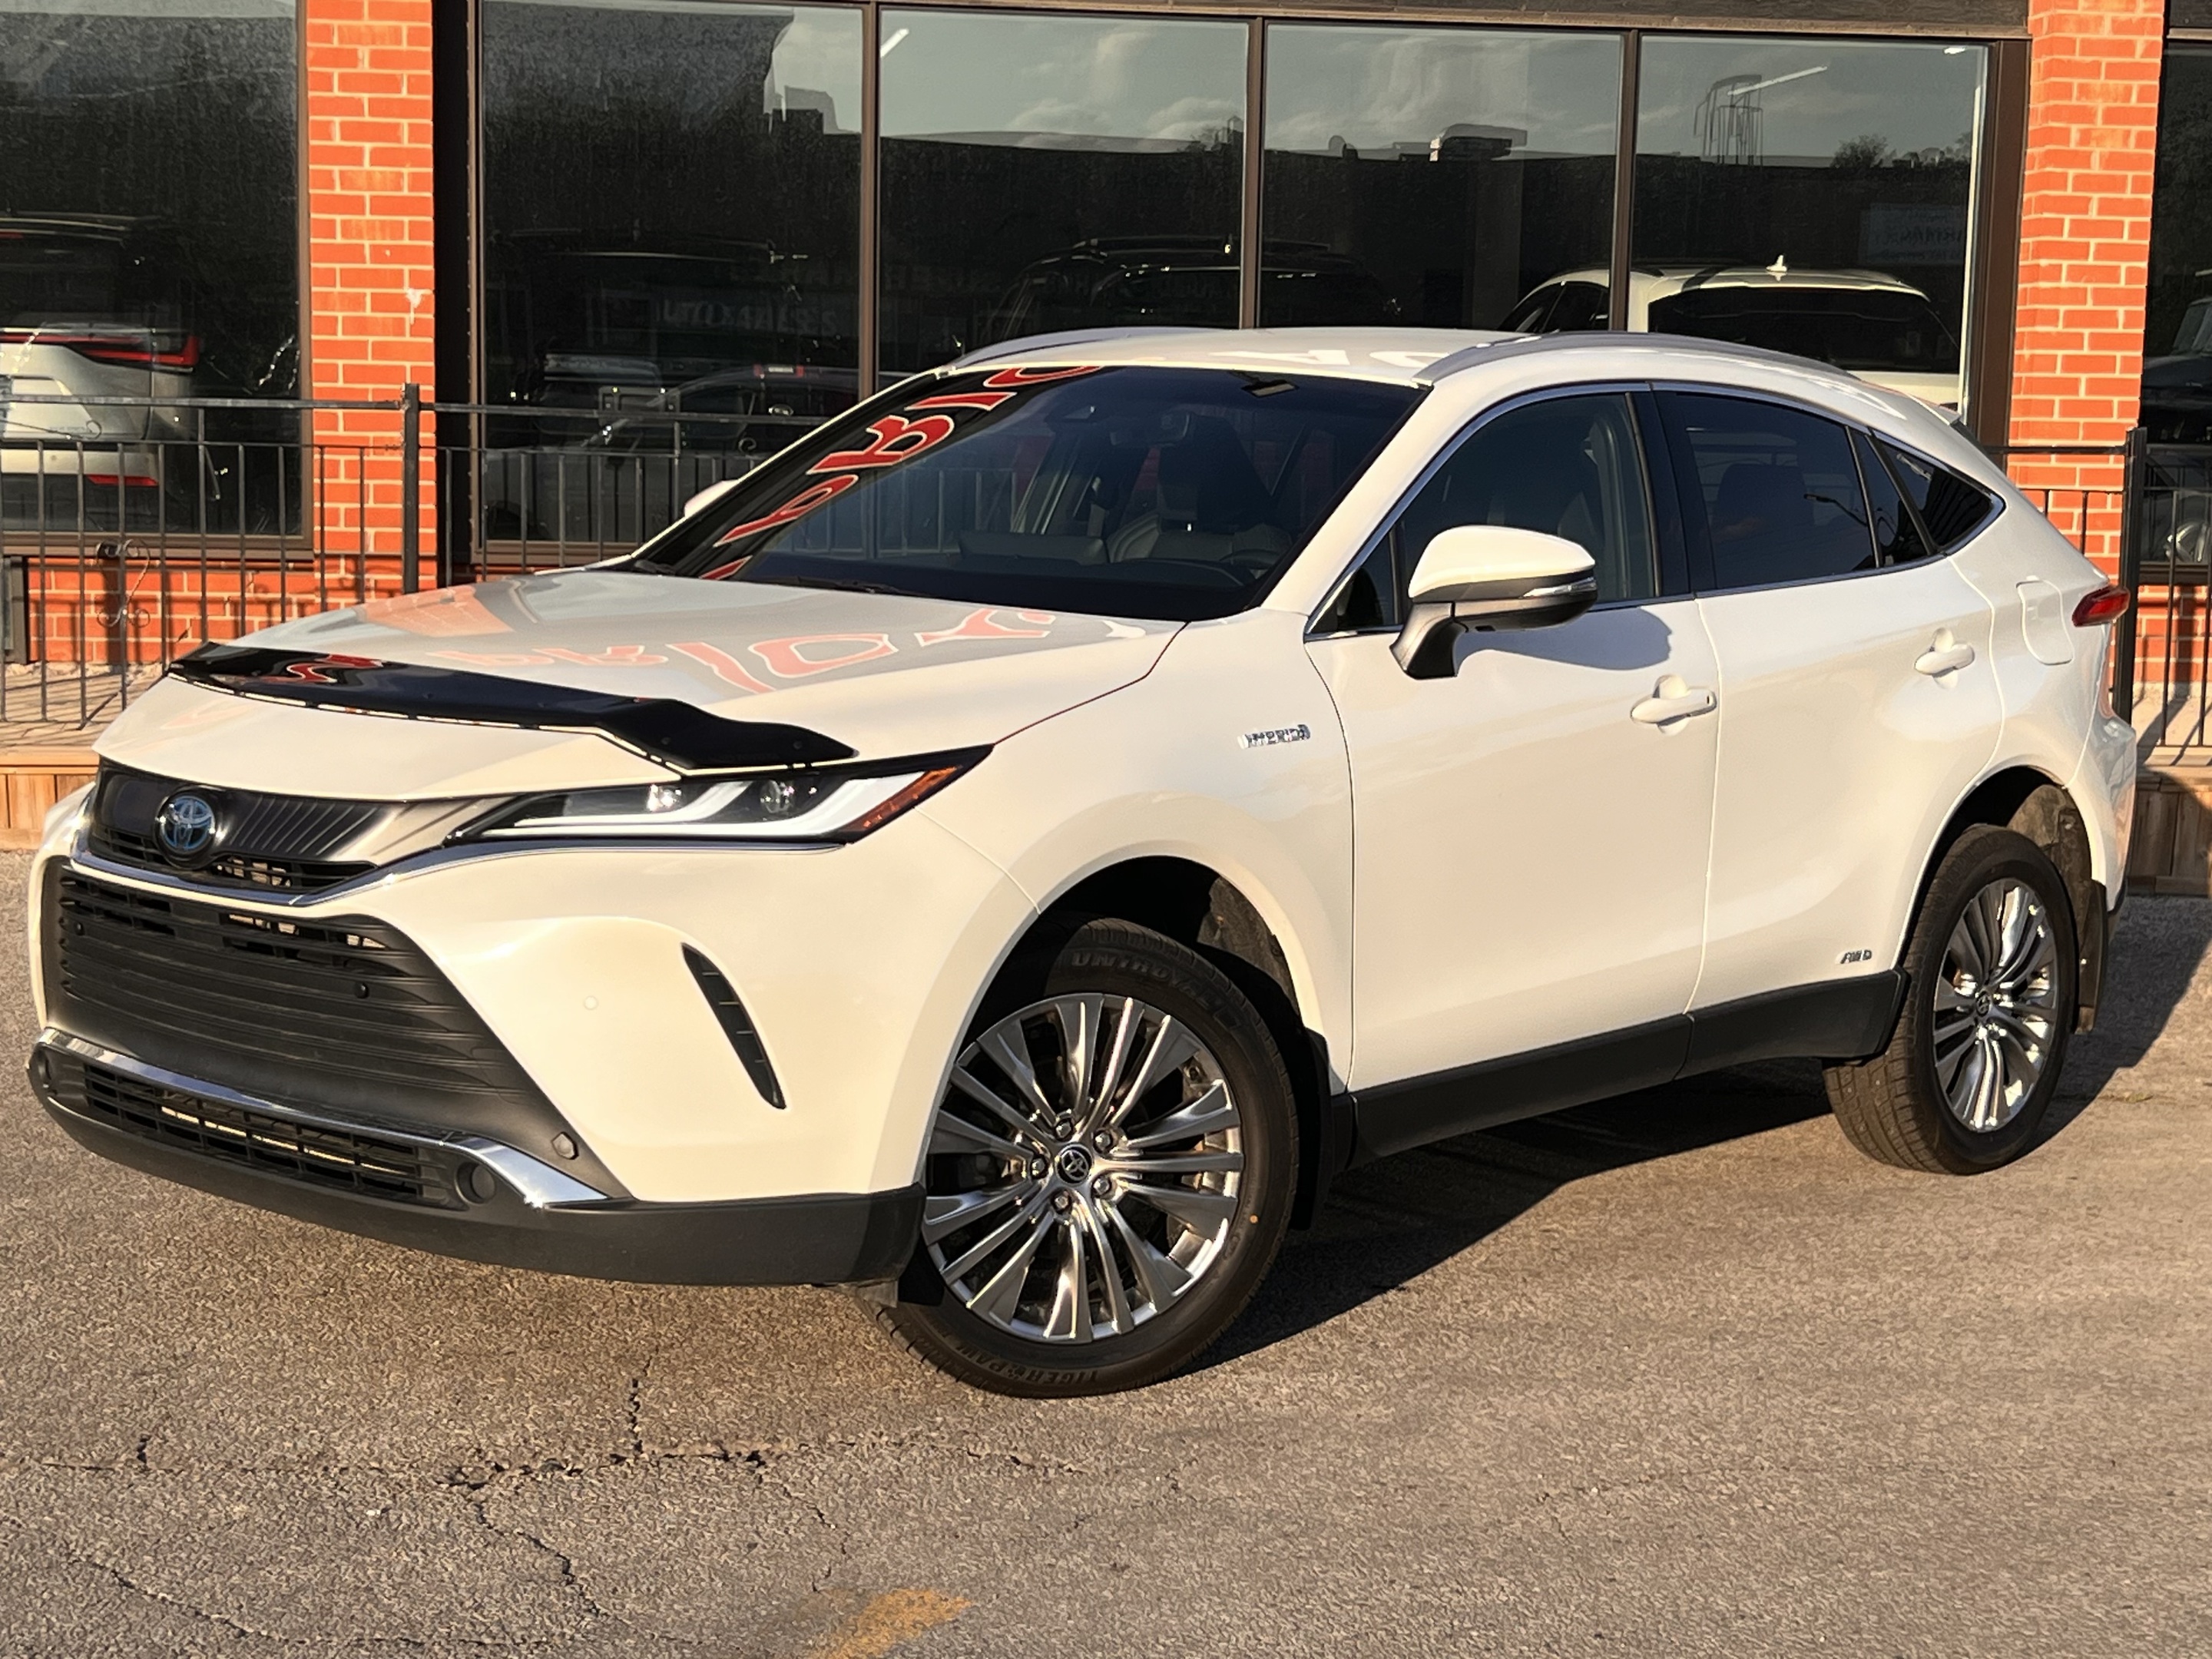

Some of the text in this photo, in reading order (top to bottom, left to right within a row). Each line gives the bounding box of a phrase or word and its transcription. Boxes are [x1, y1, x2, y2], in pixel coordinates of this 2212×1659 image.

[1237, 724, 1311, 750] HYBRID
[1838, 949, 1873, 965] AWD
[1027, 1368, 1099, 1384] TIGER
